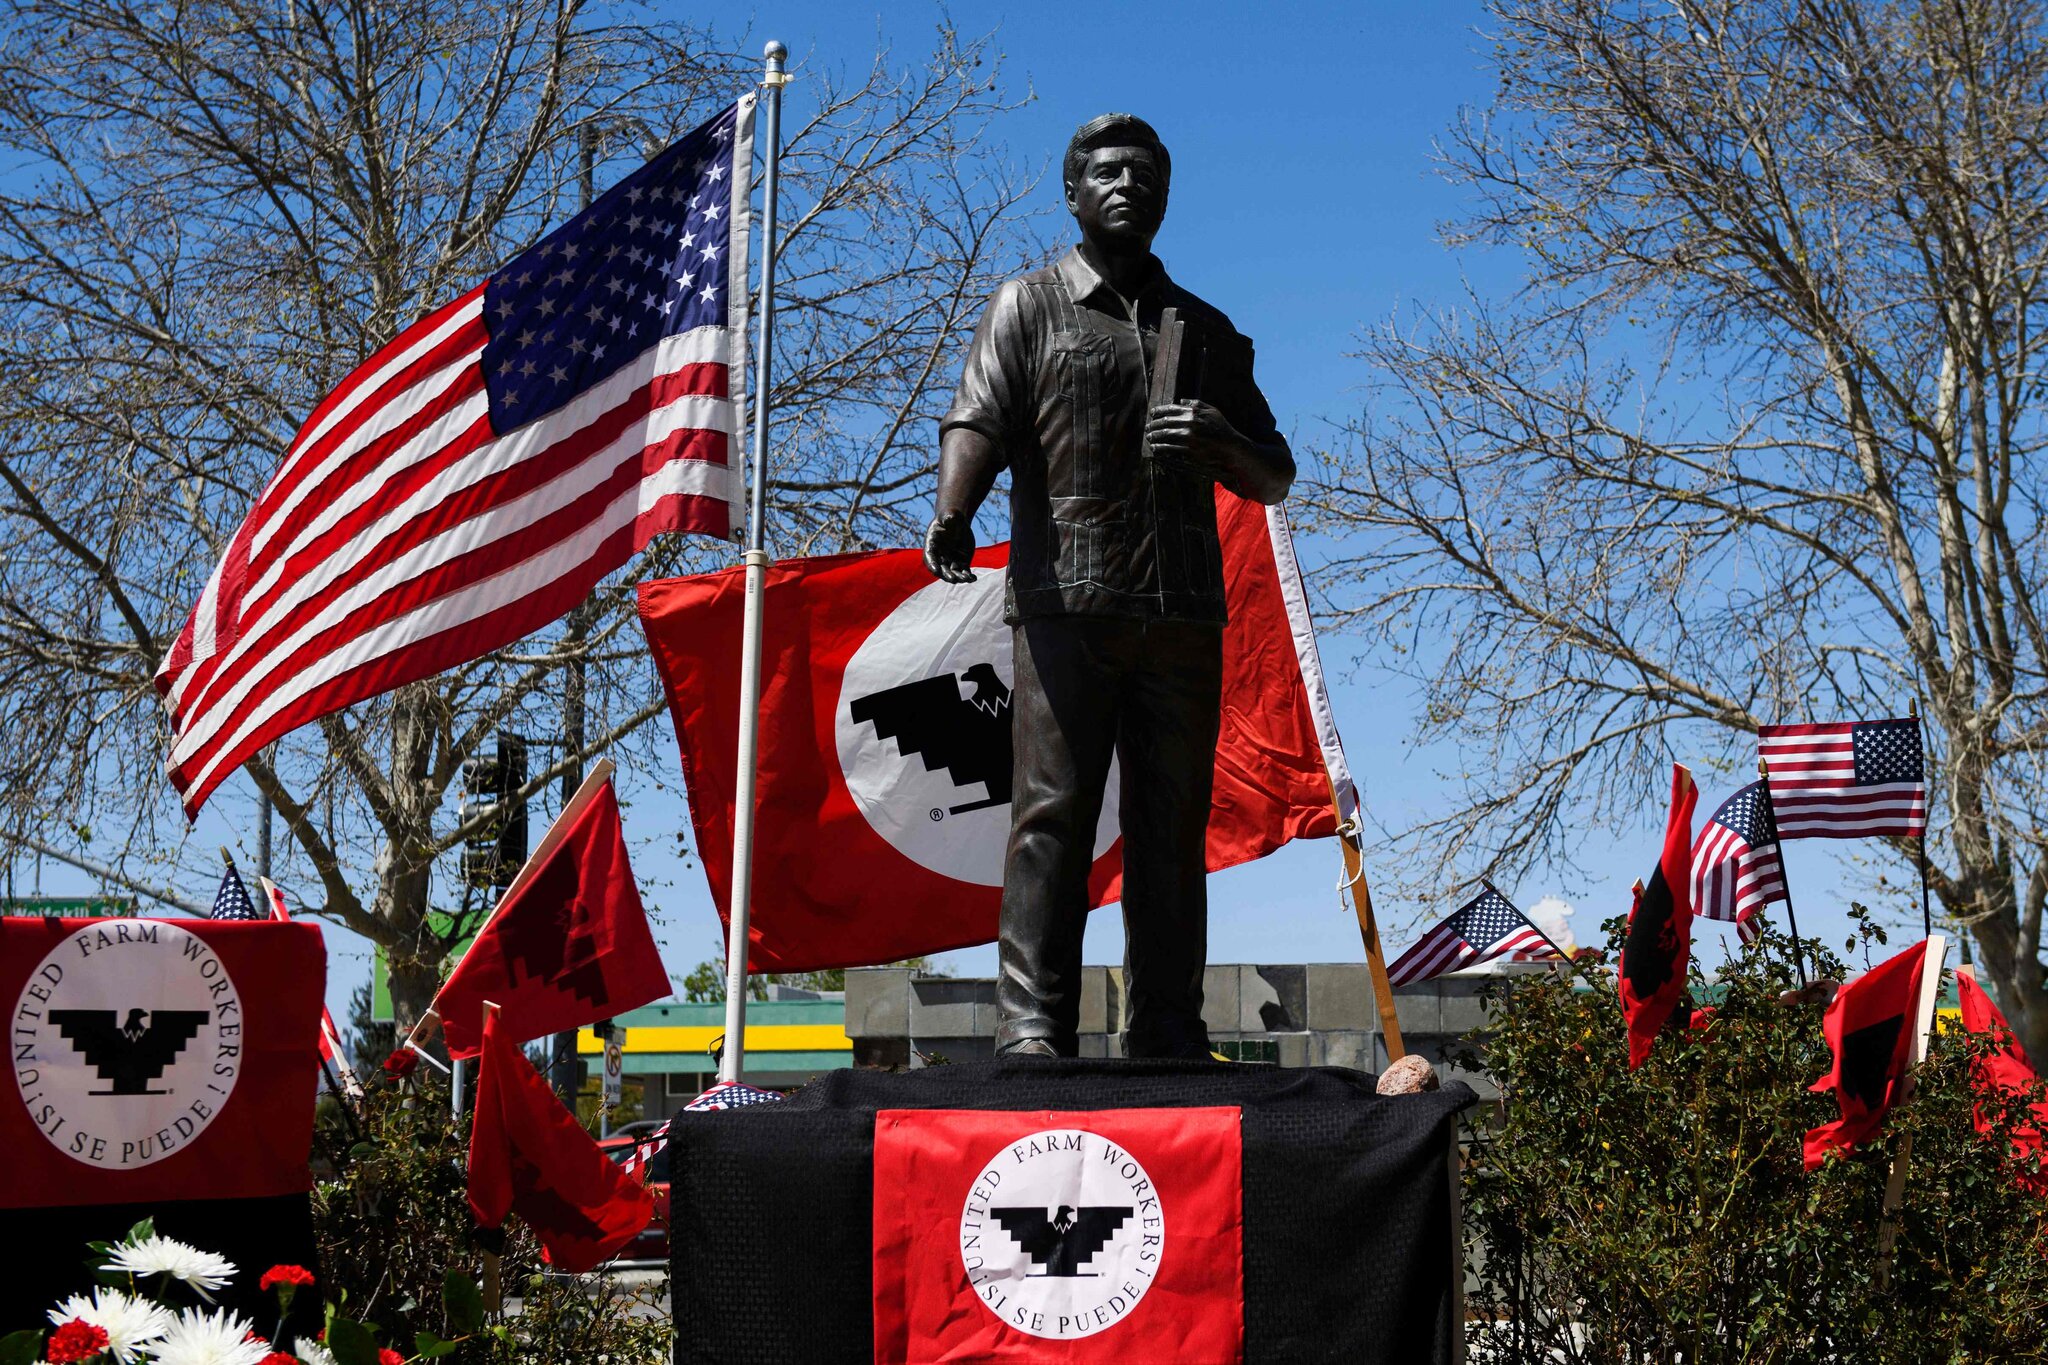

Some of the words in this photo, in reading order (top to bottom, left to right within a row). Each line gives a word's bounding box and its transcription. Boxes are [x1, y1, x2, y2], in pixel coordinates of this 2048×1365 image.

[15, 963, 64, 1089] UNITED
[75, 923, 159, 958] FARM
[182, 937, 241, 1078] WORKERS
[69, 1131, 107, 1161] SE
[964, 1169, 1001, 1272] UNITED
[1012, 1134, 1083, 1164] FARM
[1102, 1144, 1161, 1263] WORKERS
[1013, 1307, 1045, 1332] SE
